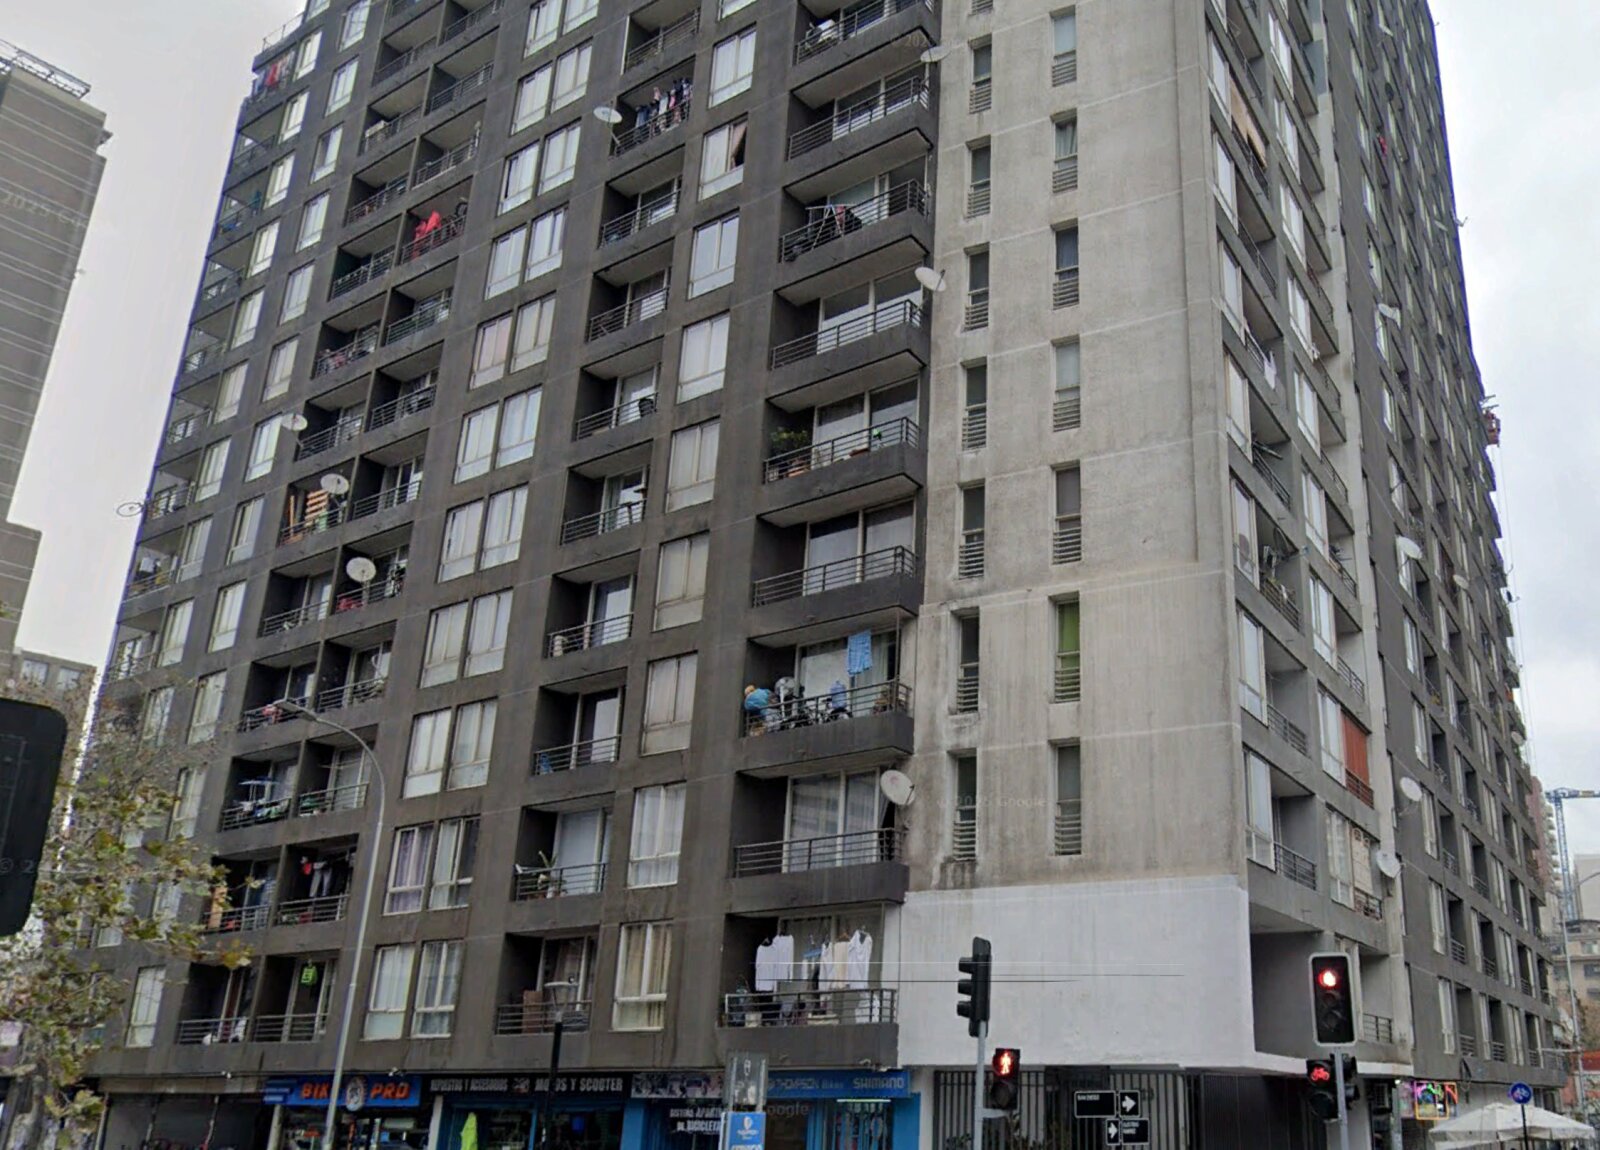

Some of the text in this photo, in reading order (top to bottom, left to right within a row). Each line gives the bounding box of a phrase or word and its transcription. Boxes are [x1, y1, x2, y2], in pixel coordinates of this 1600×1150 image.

[534, 1077, 623, 1092] MOOS Y SCOOTER
[852, 1076, 905, 1090] SHIMANO
[301, 1082, 332, 1099] BIK
[370, 1082, 411, 1100] PRO
